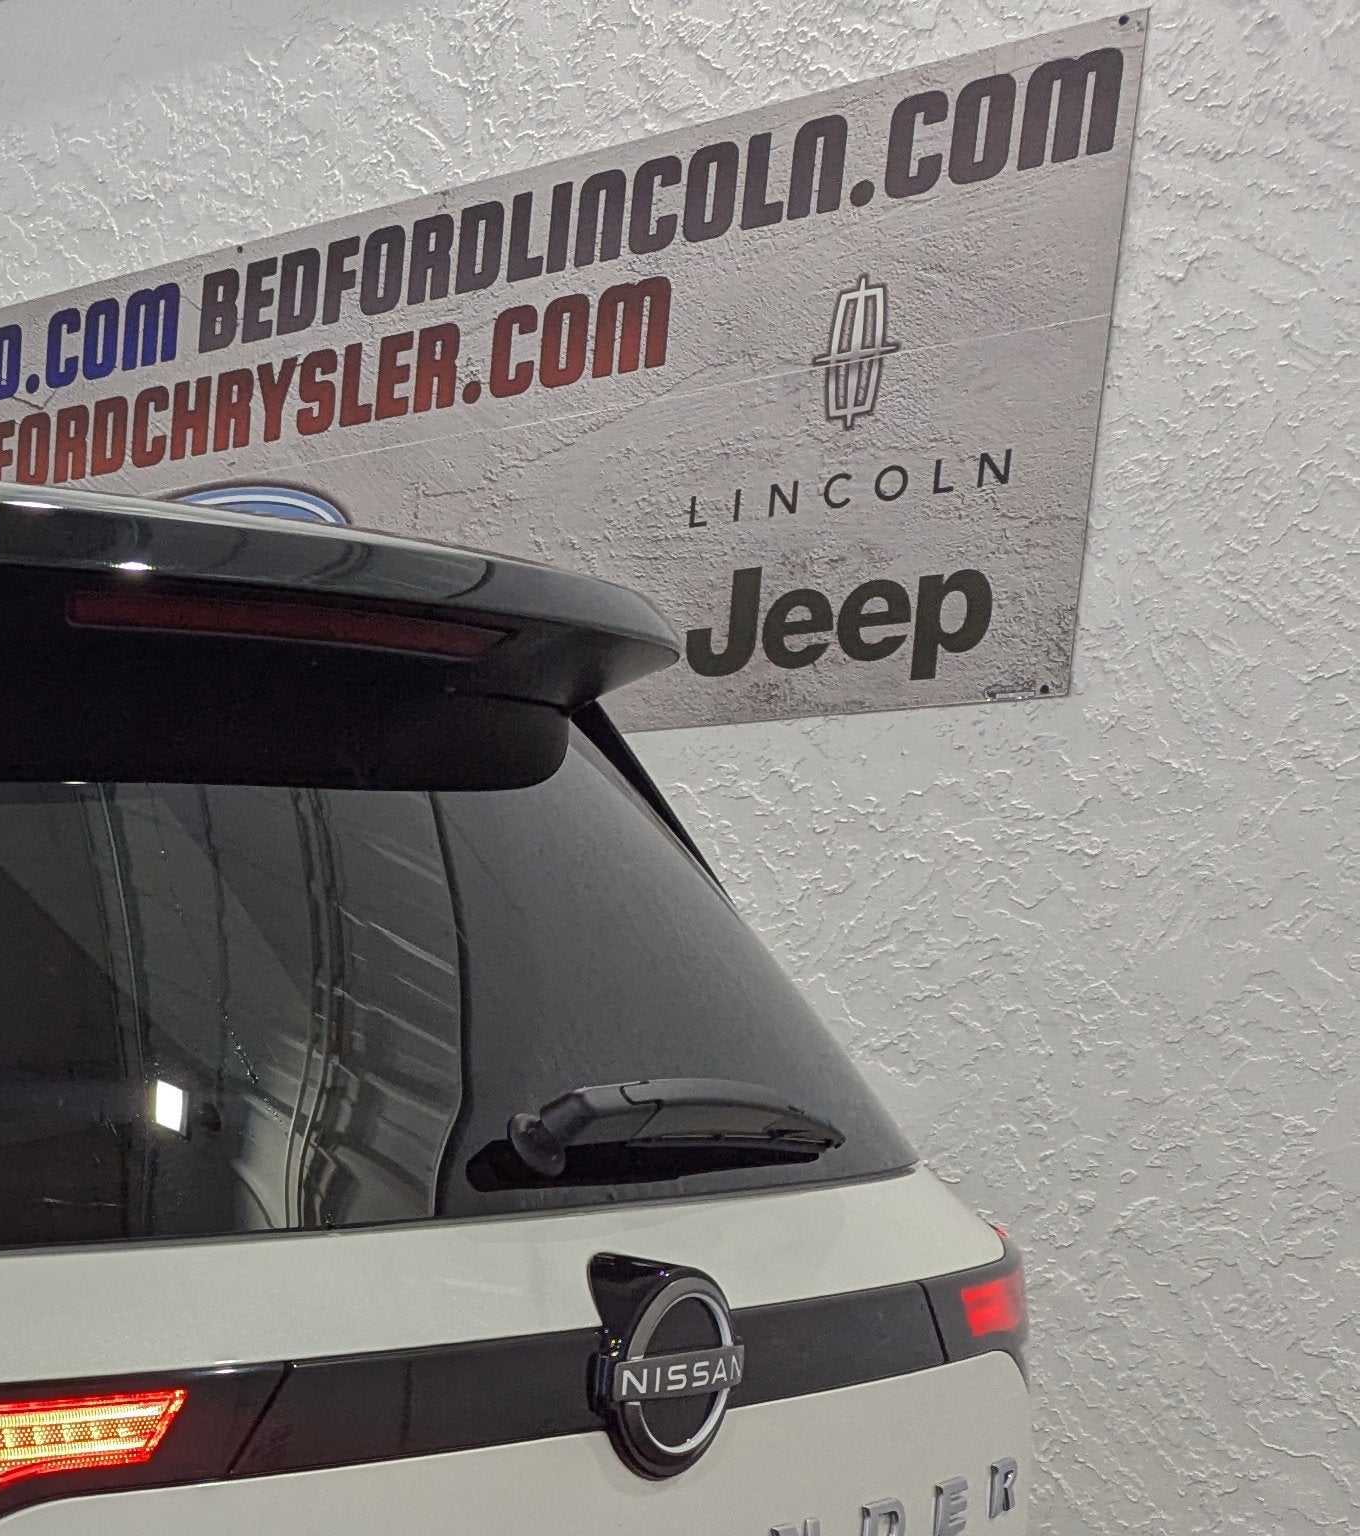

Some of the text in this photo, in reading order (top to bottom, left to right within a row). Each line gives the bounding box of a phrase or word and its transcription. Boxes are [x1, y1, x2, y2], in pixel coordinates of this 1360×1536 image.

[198, 46, 1125, 353] BEDFORDLINCOLN.COM
[686, 447, 1016, 529] LINCOLN
[686, 566, 994, 681] Jeep
[621, 1354, 742, 1396] NISSAN
